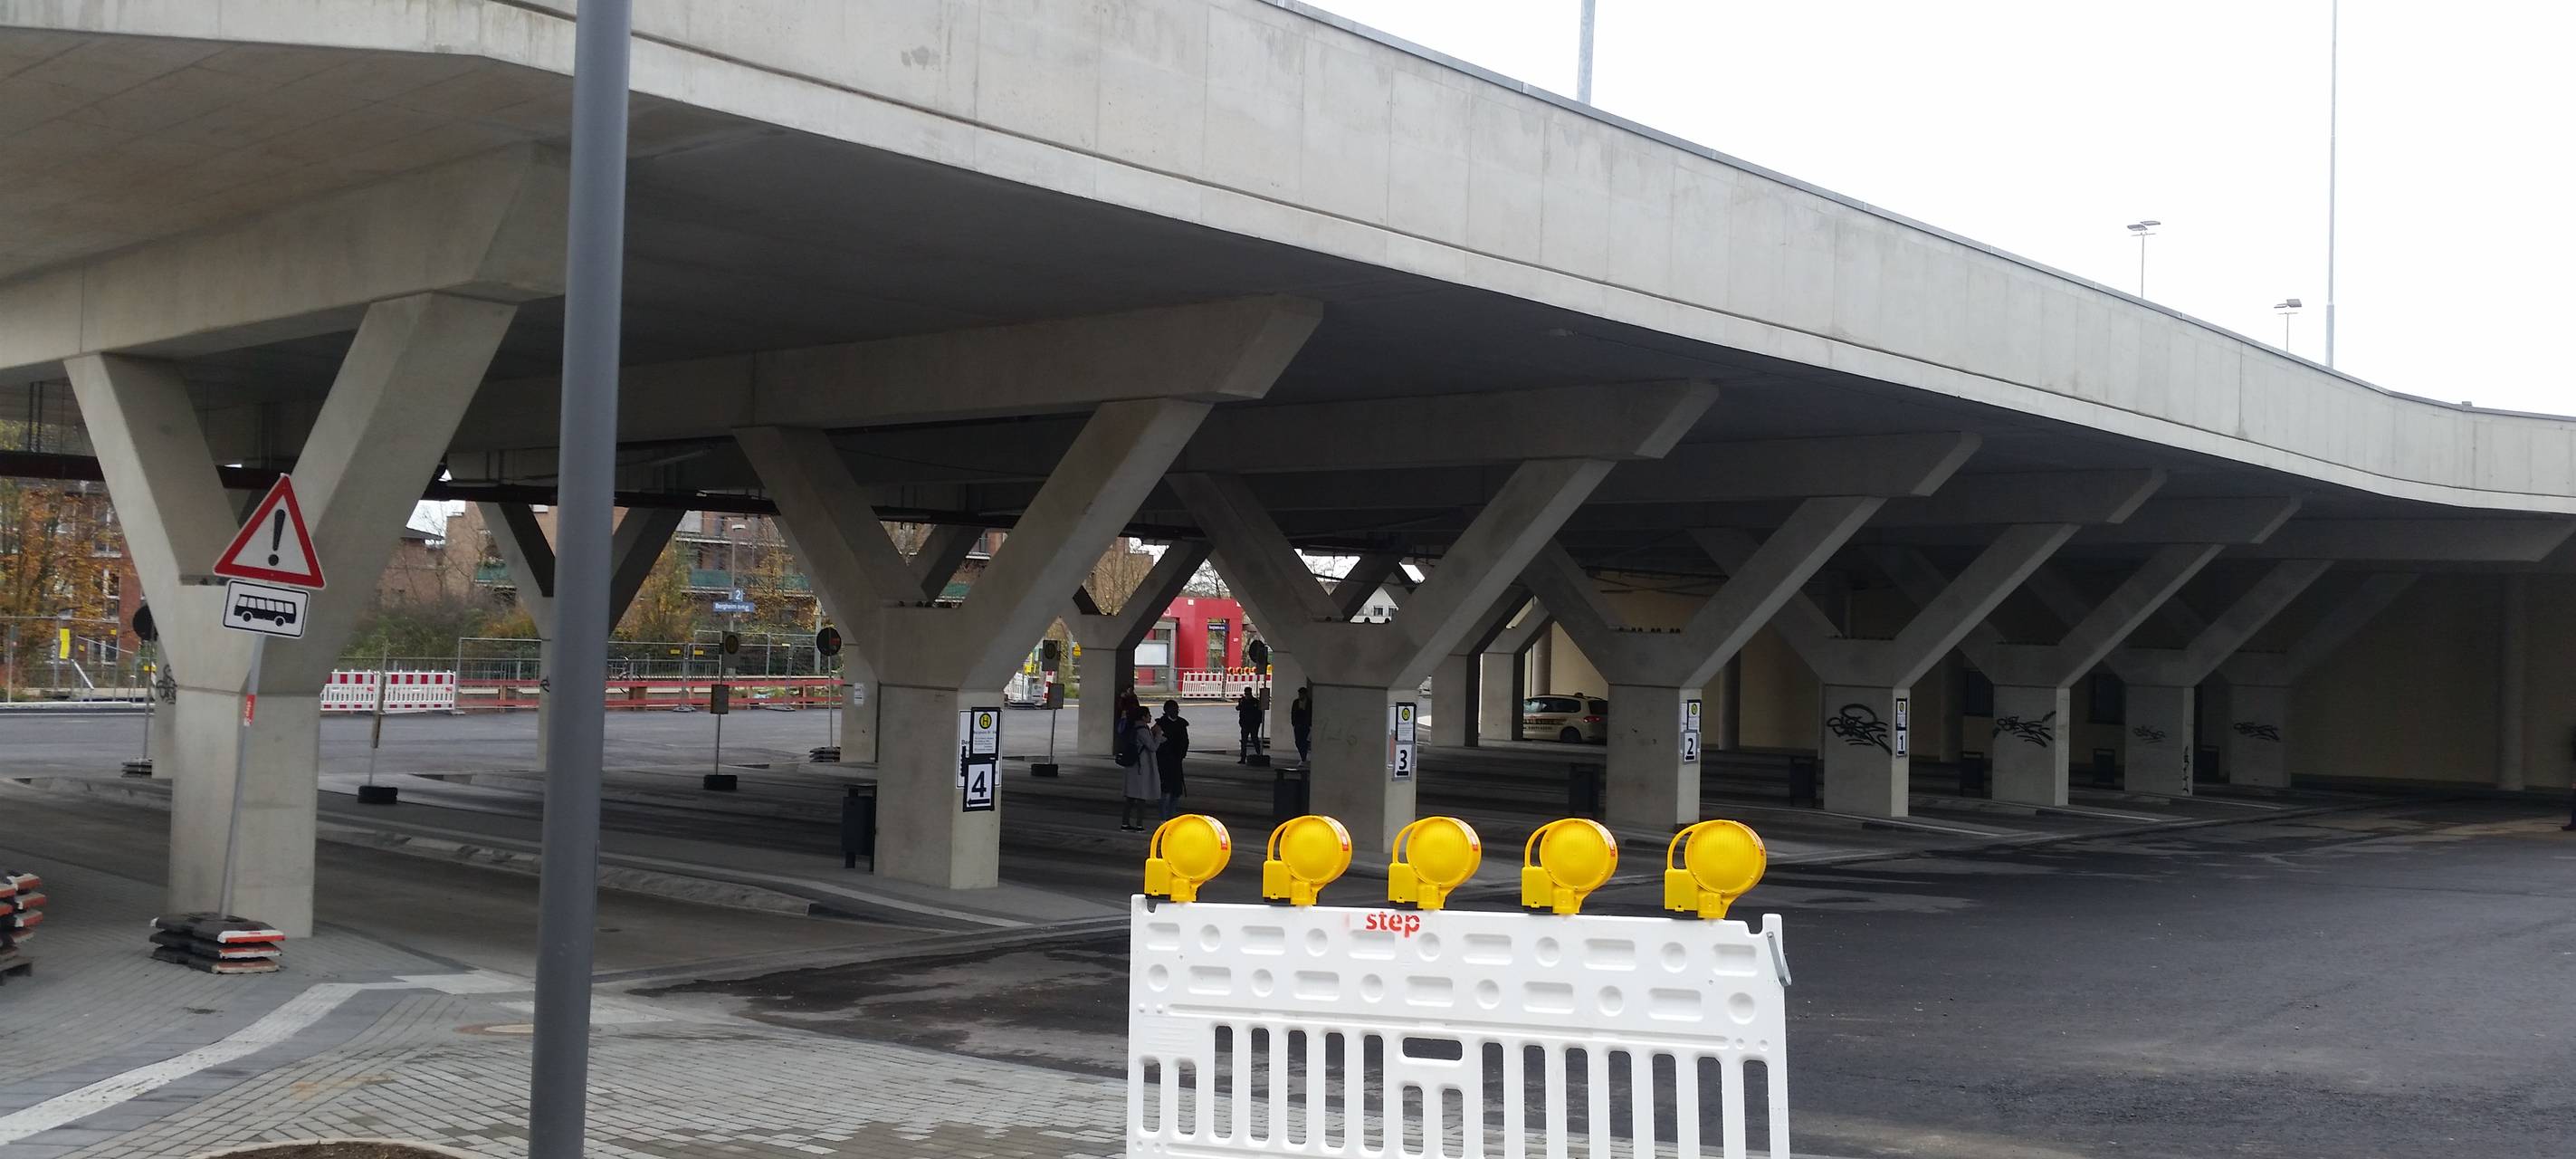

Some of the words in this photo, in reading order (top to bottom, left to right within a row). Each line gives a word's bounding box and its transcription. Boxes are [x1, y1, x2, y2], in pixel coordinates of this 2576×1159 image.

[735, 589, 740, 600] 2
[982, 716, 989, 726] H
[1687, 737, 1693, 755] 2
[1899, 735, 1903, 751] 1
[1398, 749, 1407, 771] 3
[971, 771, 987, 798] 4
[1365, 911, 1420, 938] step
